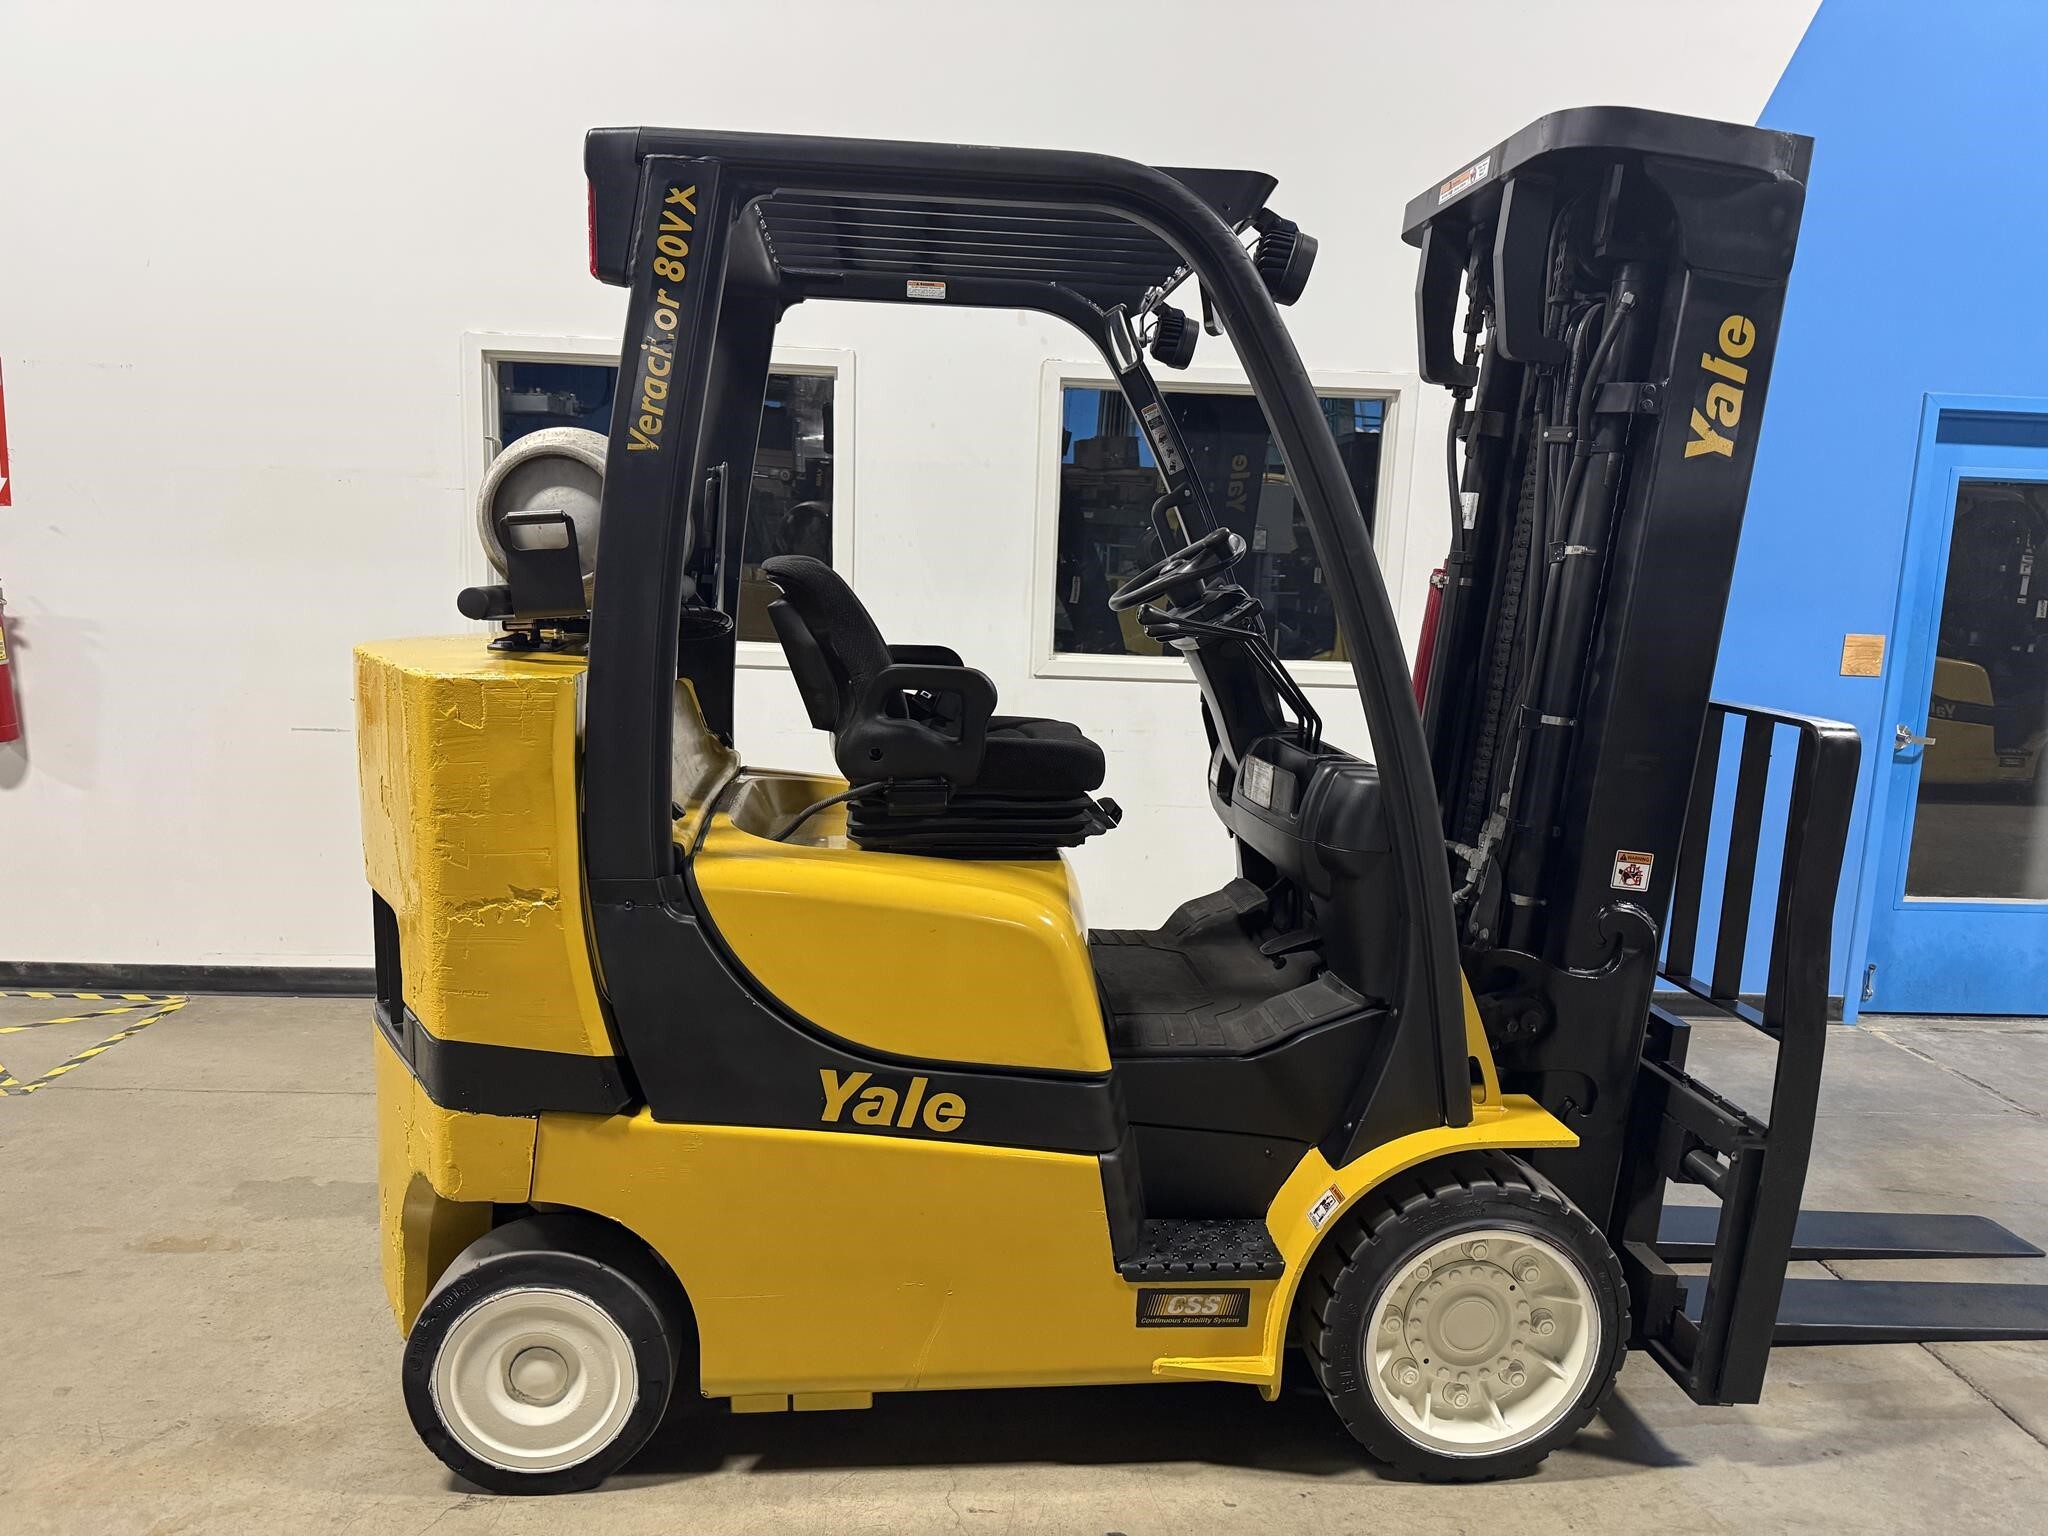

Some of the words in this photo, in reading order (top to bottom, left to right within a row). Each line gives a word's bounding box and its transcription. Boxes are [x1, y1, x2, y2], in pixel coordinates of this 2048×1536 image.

[653, 184, 697, 283] 80VX
[627, 288, 680, 452] Veracior
[1684, 314, 1756, 458] Yale
[1627, 855, 1649, 863] WARNING
[819, 1068, 967, 1133] Yale
